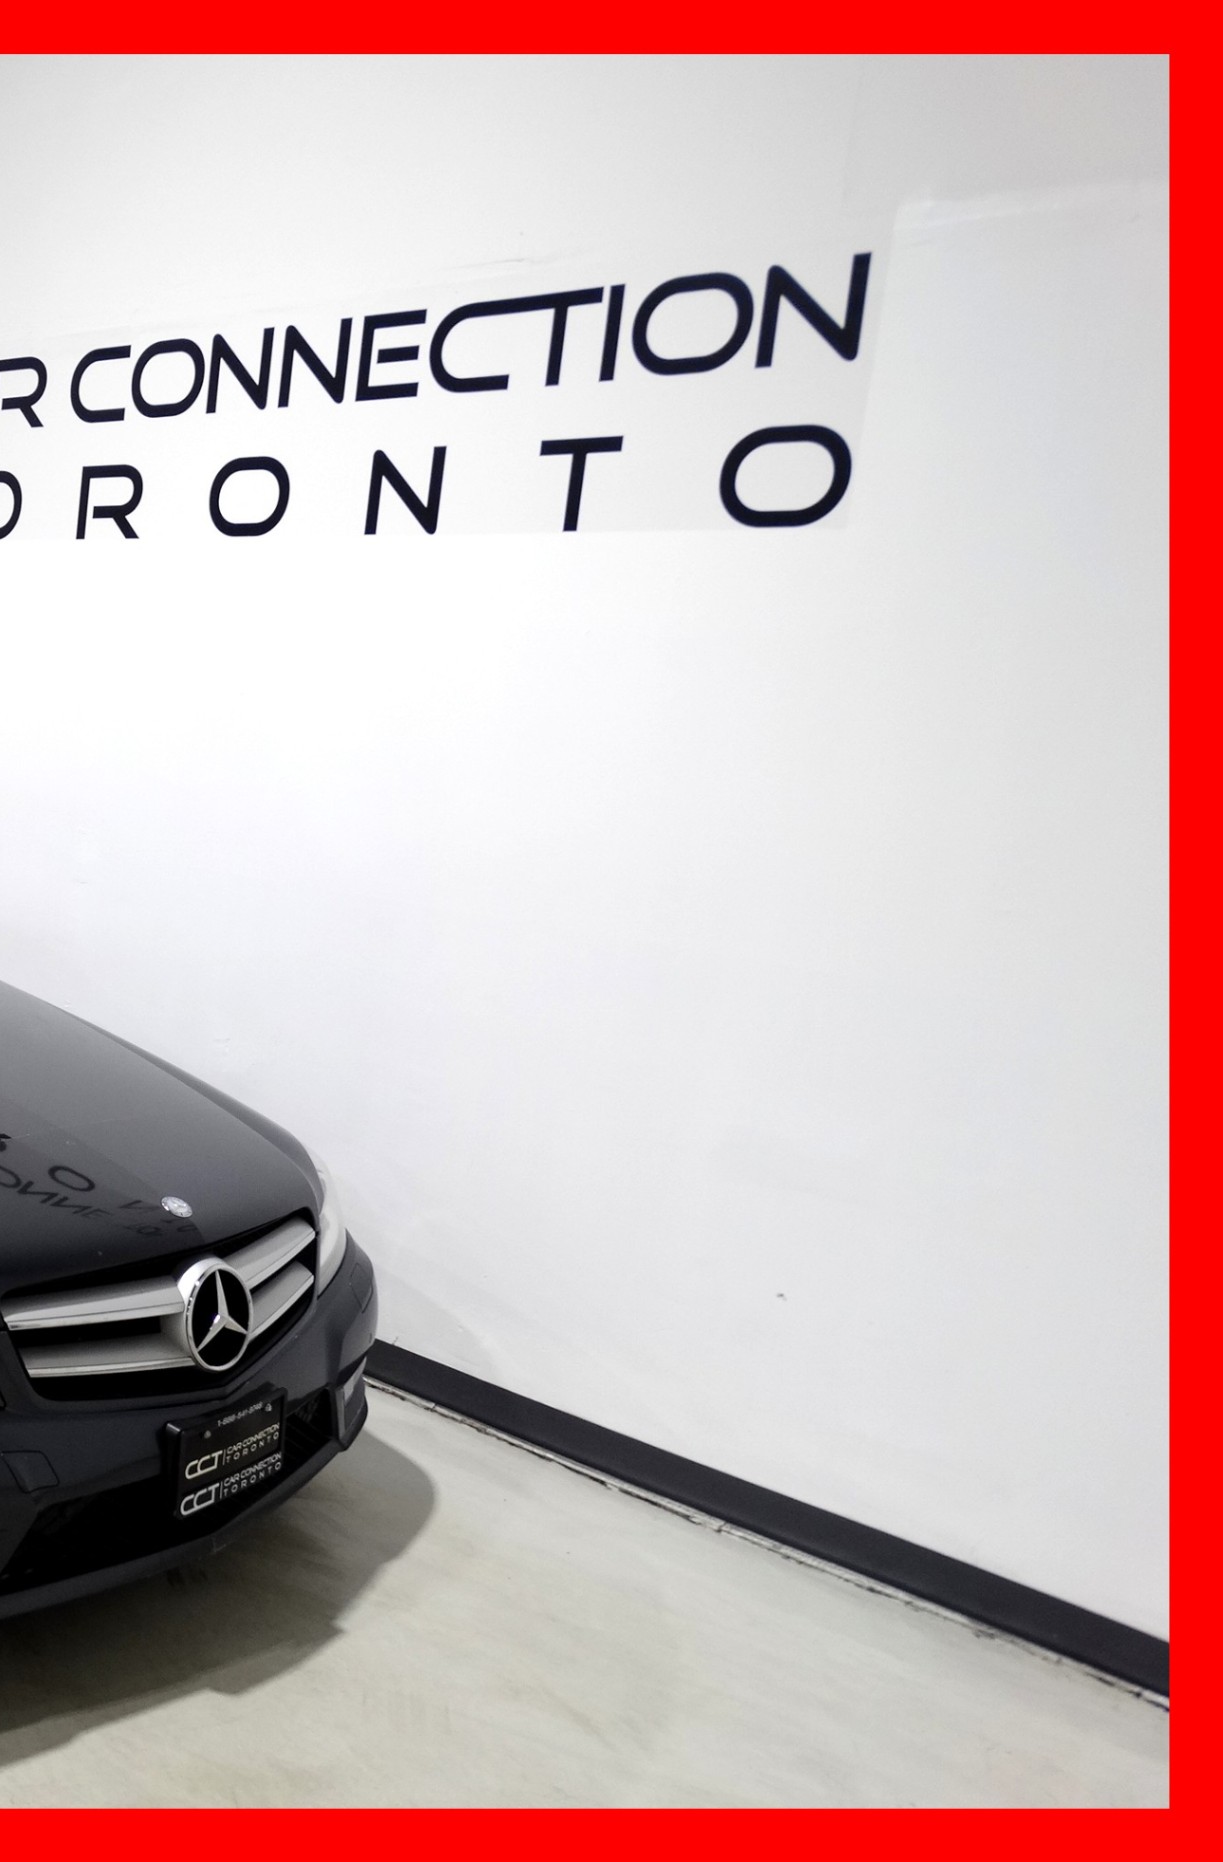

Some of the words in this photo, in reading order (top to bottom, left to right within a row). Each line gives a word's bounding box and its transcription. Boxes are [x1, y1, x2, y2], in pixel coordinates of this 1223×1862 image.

[71, 253, 871, 423] CONNECTION
[226, 1441, 242, 1454] CAR
[241, 1422, 280, 1449] CONNECTION
[226, 1431, 279, 1463] TORONTO
[185, 1450, 223, 1479] CCT
[223, 1473, 240, 1487] CAR
[240, 1452, 281, 1478] CONNECTION
[223, 1461, 281, 1497] TORONTO
[180, 1483, 220, 1516] CCT
